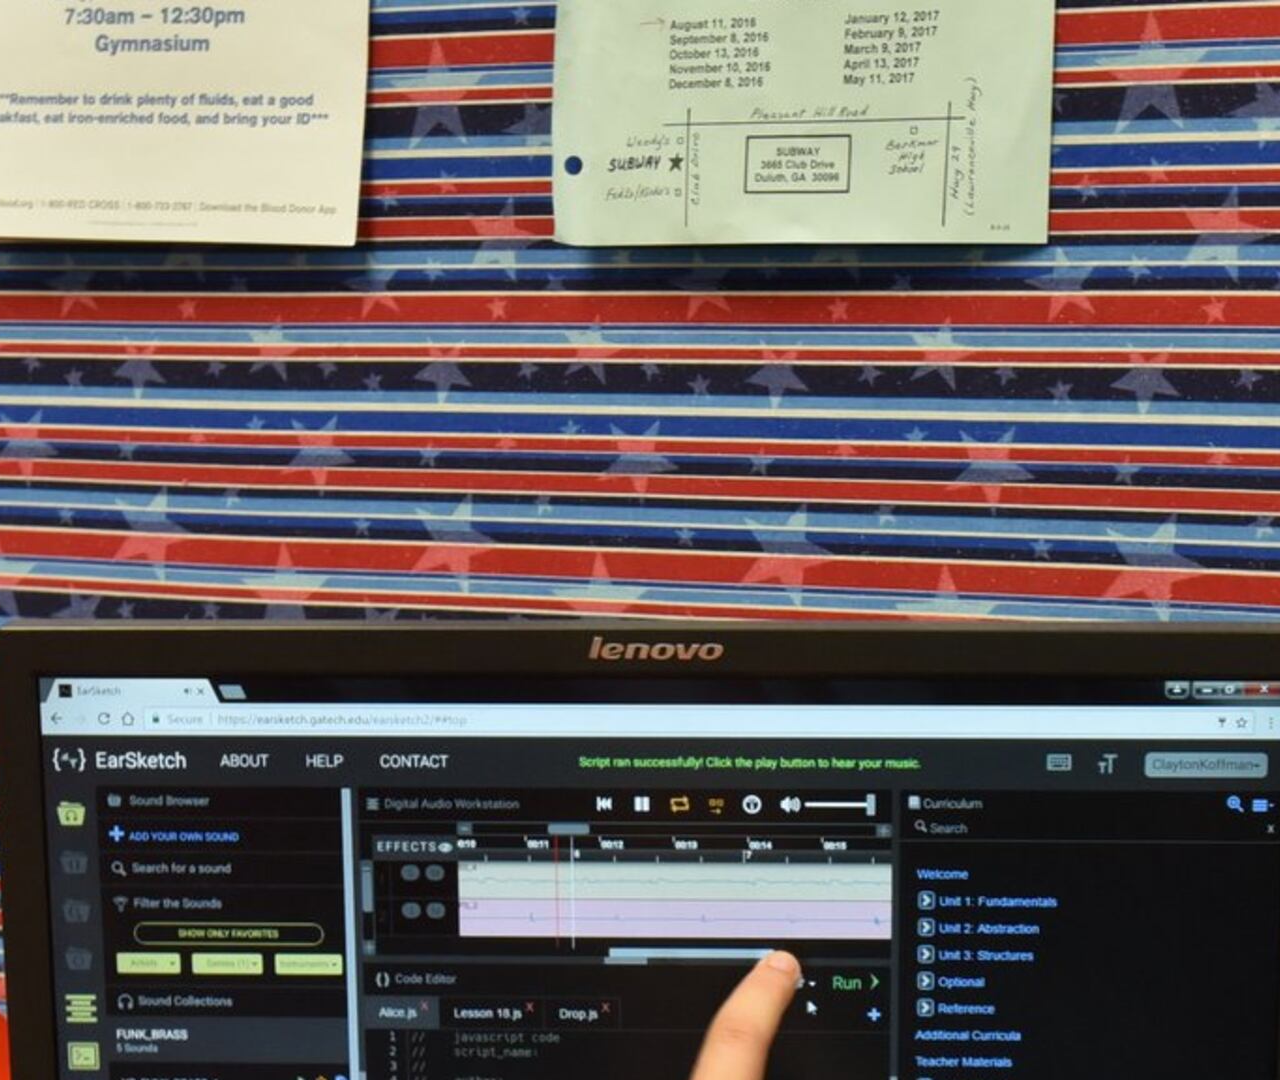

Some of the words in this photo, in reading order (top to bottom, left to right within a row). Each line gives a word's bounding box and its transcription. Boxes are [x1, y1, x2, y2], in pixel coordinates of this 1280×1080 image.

[65, 8, 134, 25] 7:30am
[161, 7, 245, 28] 12:30pm
[844, 14, 889, 25] January
[914, 10, 940, 22] 2017
[670, 20, 708, 32] August
[730, 17, 757, 28] 2016
[670, 34, 727, 46] September
[744, 32, 769, 43] 2016
[844, 28, 894, 40] February
[912, 26, 938, 38] 2017
[95, 34, 210, 55] Gymnasium
[844, 44, 878, 54] March
[895, 41, 921, 53] 2017
[670, 49, 711, 60] October
[734, 46, 759, 58] 2016
[670, 64, 723, 74] November
[746, 61, 771, 72] 2016
[844, 59, 871, 71] April
[894, 57, 920, 68] 2017
[669, 79, 722, 90] December
[738, 76, 763, 88] 2016
[844, 74, 865, 86] May
[889, 72, 914, 84] 2017
[83, 93, 96, 106] to
[100, 93, 132, 106] drink
[137, 94, 176, 108] plenty
[181, 93, 196, 106] of
[199, 93, 238, 108] fluids,
[242, 94, 263, 106] eat
[267, 97, 276, 106] a
[280, 94, 314, 108] good
[44, 113, 64, 124] eat
[68, 112, 154, 124] iron-enriched
[158, 112, 190, 126] food,
[195, 113, 218, 125] and
[223, 113, 258, 128] bring
[262, 116, 292, 128] your
[776, 146, 820, 156] SUBWAY
[608, 155, 661, 172] SUBWAY
[785, 160, 808, 170] Club
[810, 160, 835, 170] Drive
[754, 172, 788, 183] Duluth,
[792, 172, 806, 182] GA
[588, 636, 724, 661] lenovo
[96, 750, 186, 770] EarSketch
[220, 754, 269, 768] ABOUT
[306, 754, 344, 768] HELP
[380, 754, 448, 768] CONTACT
[579, 756, 610, 770] Script
[613, 758, 631, 768] ran
[633, 756, 703, 770] successfully!
[706, 756, 732, 768] Click
[735, 756, 752, 768] the
[755, 757, 778, 770] play
[780, 756, 816, 768] button
[818, 758, 830, 768] to
[831, 756, 856, 768] hear
[859, 760, 882, 771] your
[886, 758, 922, 769] music.
[130, 795, 163, 806] Sound
[166, 796, 210, 806] Browser
[384, 798, 418, 812] Digital
[422, 798, 452, 810] Audio
[456, 798, 520, 810] Workstation
[923, 797, 983, 810] Curriculum
[930, 822, 968, 834] Search
[129, 832, 150, 842] ADD
[151, 832, 178, 842] YOUR
[180, 832, 203, 842] OWN
[205, 832, 240, 842] SOUND
[376, 841, 436, 852] EFFECTS
[132, 862, 170, 874] Search
[171, 862, 186, 873] for
[190, 864, 196, 873] a
[199, 862, 232, 874] sound
[917, 868, 969, 880] Welcome
[134, 898, 160, 908] Filter
[163, 898, 180, 908] the
[182, 898, 222, 909] Sounds
[939, 896, 962, 908] Unit
[978, 896, 1058, 908] Fundamentals
[178, 928, 205, 939] SHOW
[206, 929, 229, 939] ONLY
[232, 929, 279, 940] FAVORITES
[938, 924, 961, 934] Unit
[977, 924, 1040, 934] Abstraction
[938, 950, 961, 961] Unit
[977, 950, 1034, 962] Structures
[396, 974, 422, 984] Code
[426, 974, 456, 984] Editor
[832, 976, 862, 990] Run
[938, 976, 986, 988] Optional
[138, 996, 172, 1006] Sound
[174, 996, 233, 1007] Collections
[379, 1007, 418, 1020] Alice.js
[454, 1008, 494, 1020] Lesson
[559, 1008, 598, 1021] Drop.js
[938, 1003, 996, 1014] Reference
[116, 1029, 188, 1041] FUNK_BRASS
[455, 1031, 524, 1044] javascript
[532, 1032, 560, 1043] code
[914, 1030, 970, 1041] Additional
[972, 1030, 1022, 1041] Curricula
[915, 1056, 960, 1067] Teacher
[962, 1056, 1012, 1068] Materials
